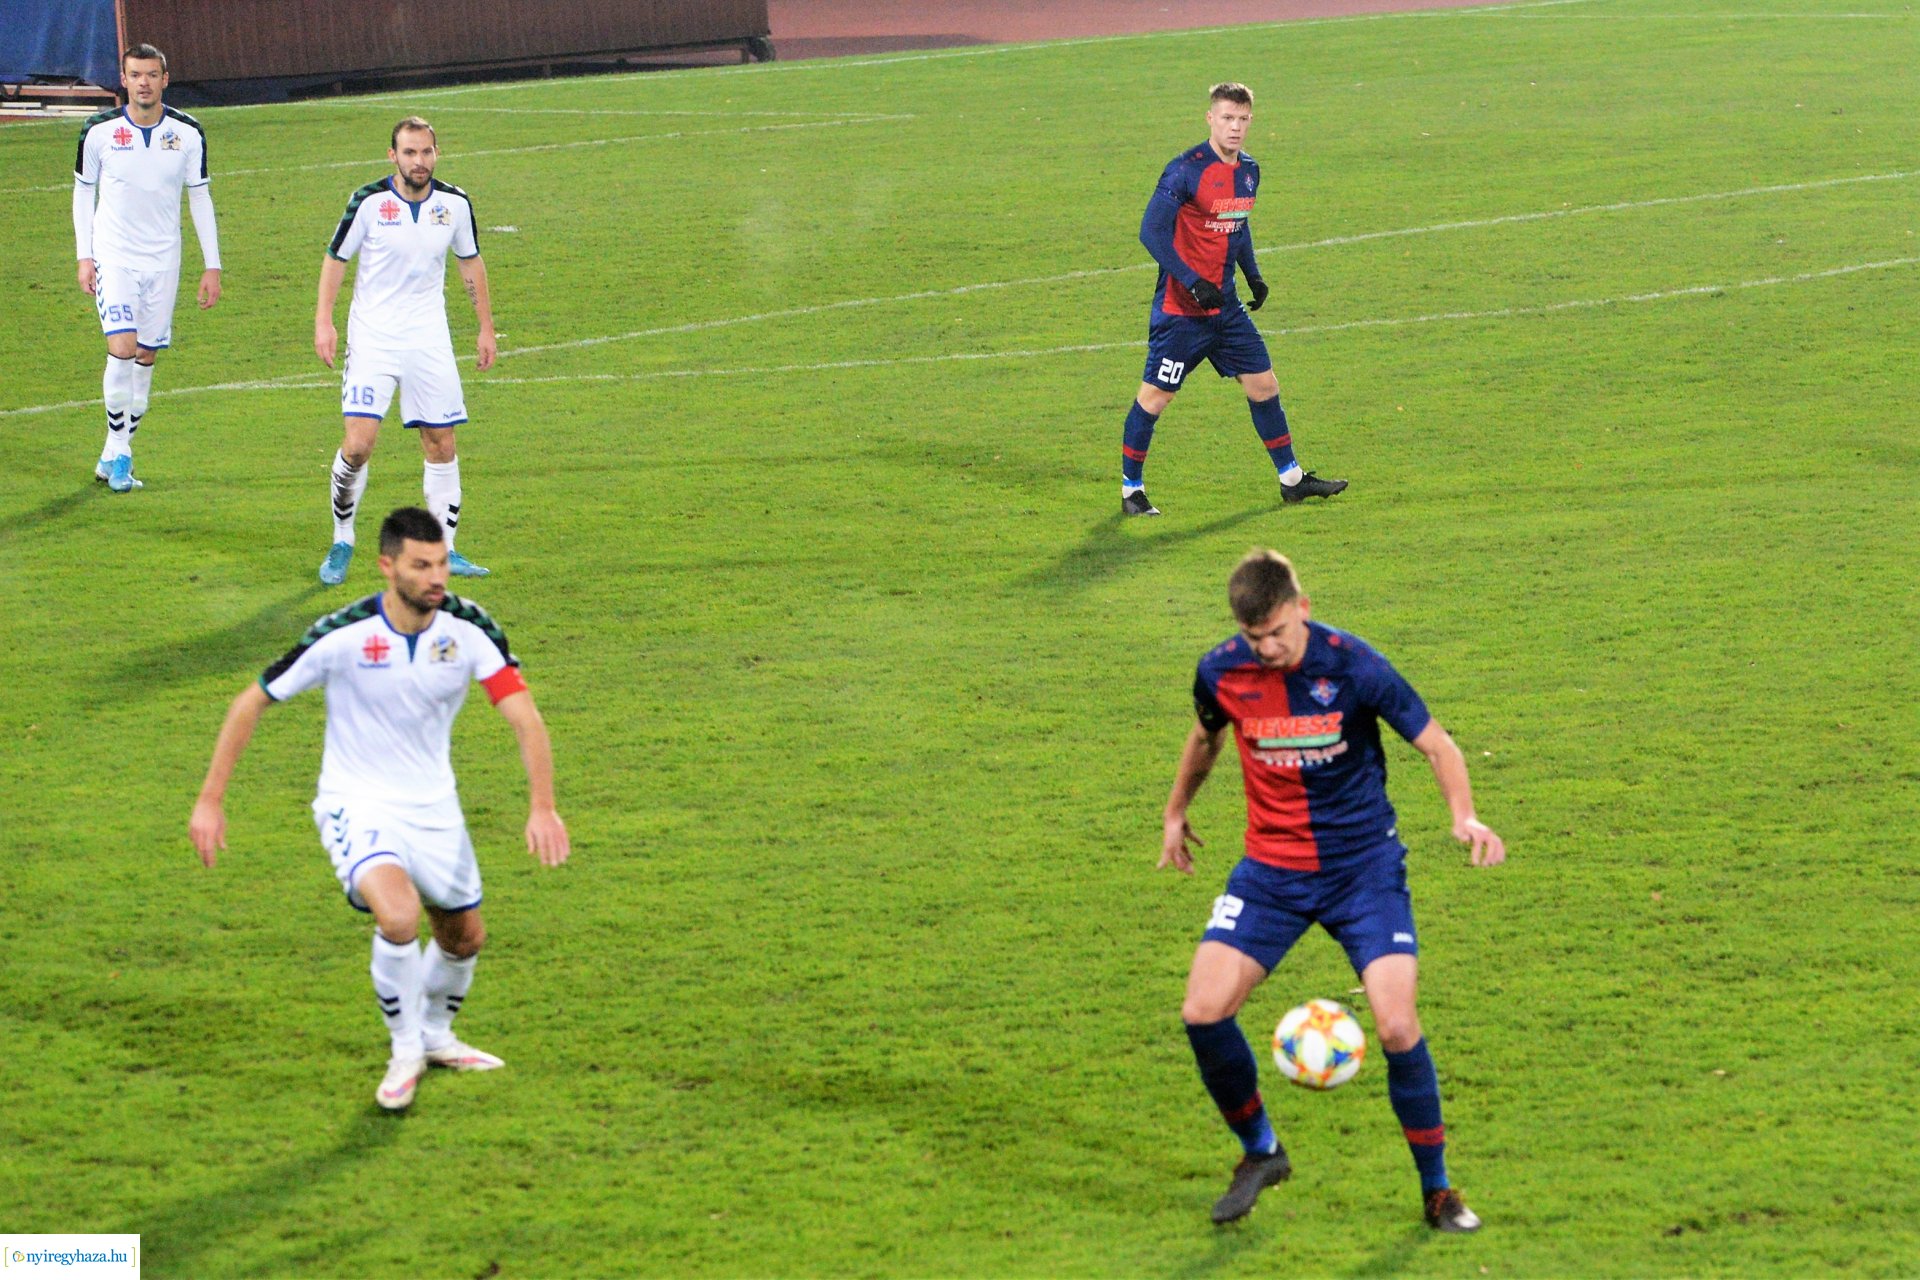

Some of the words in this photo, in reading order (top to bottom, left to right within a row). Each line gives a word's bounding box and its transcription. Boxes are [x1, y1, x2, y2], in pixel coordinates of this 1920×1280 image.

[109, 305, 133, 322] 55
[1157, 357, 1185, 384] 20
[350, 386, 375, 405] 16
[364, 829, 379, 847] 7
